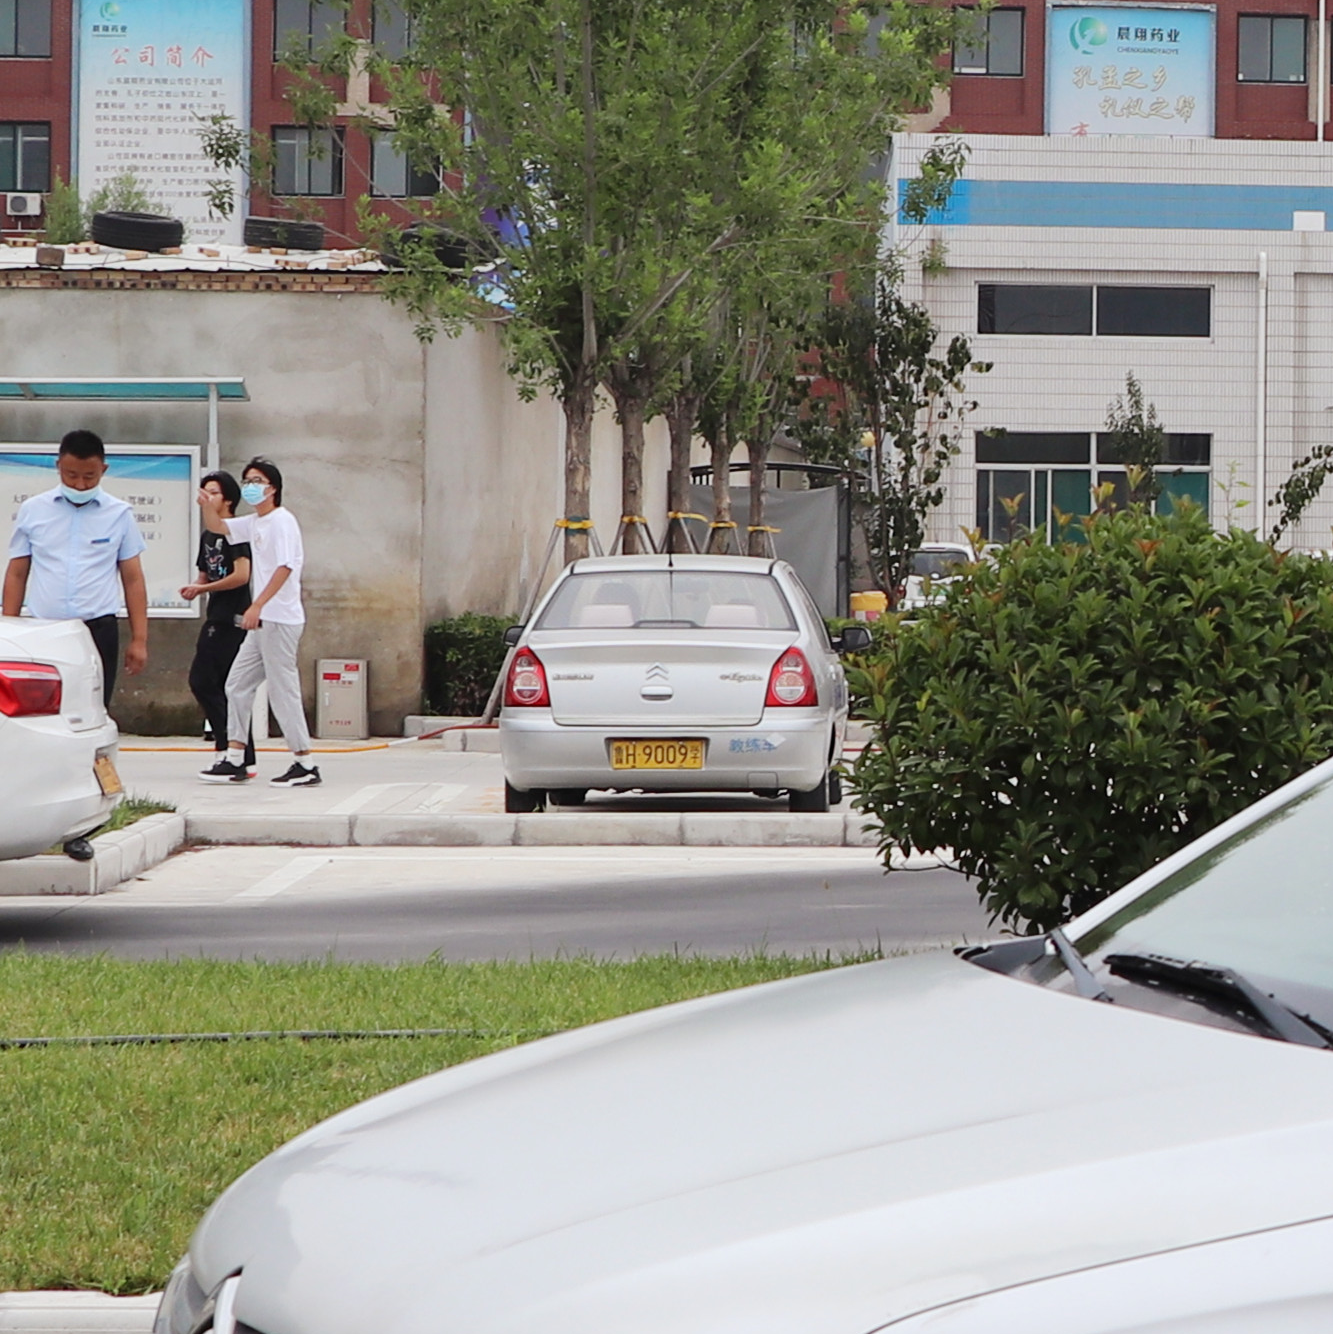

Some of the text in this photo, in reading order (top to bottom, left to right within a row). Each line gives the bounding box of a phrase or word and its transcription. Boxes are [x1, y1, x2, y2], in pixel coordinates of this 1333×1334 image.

[1117, 26, 1180, 43] 晨翔药业
[111, 45, 214, 68] 公司简介
